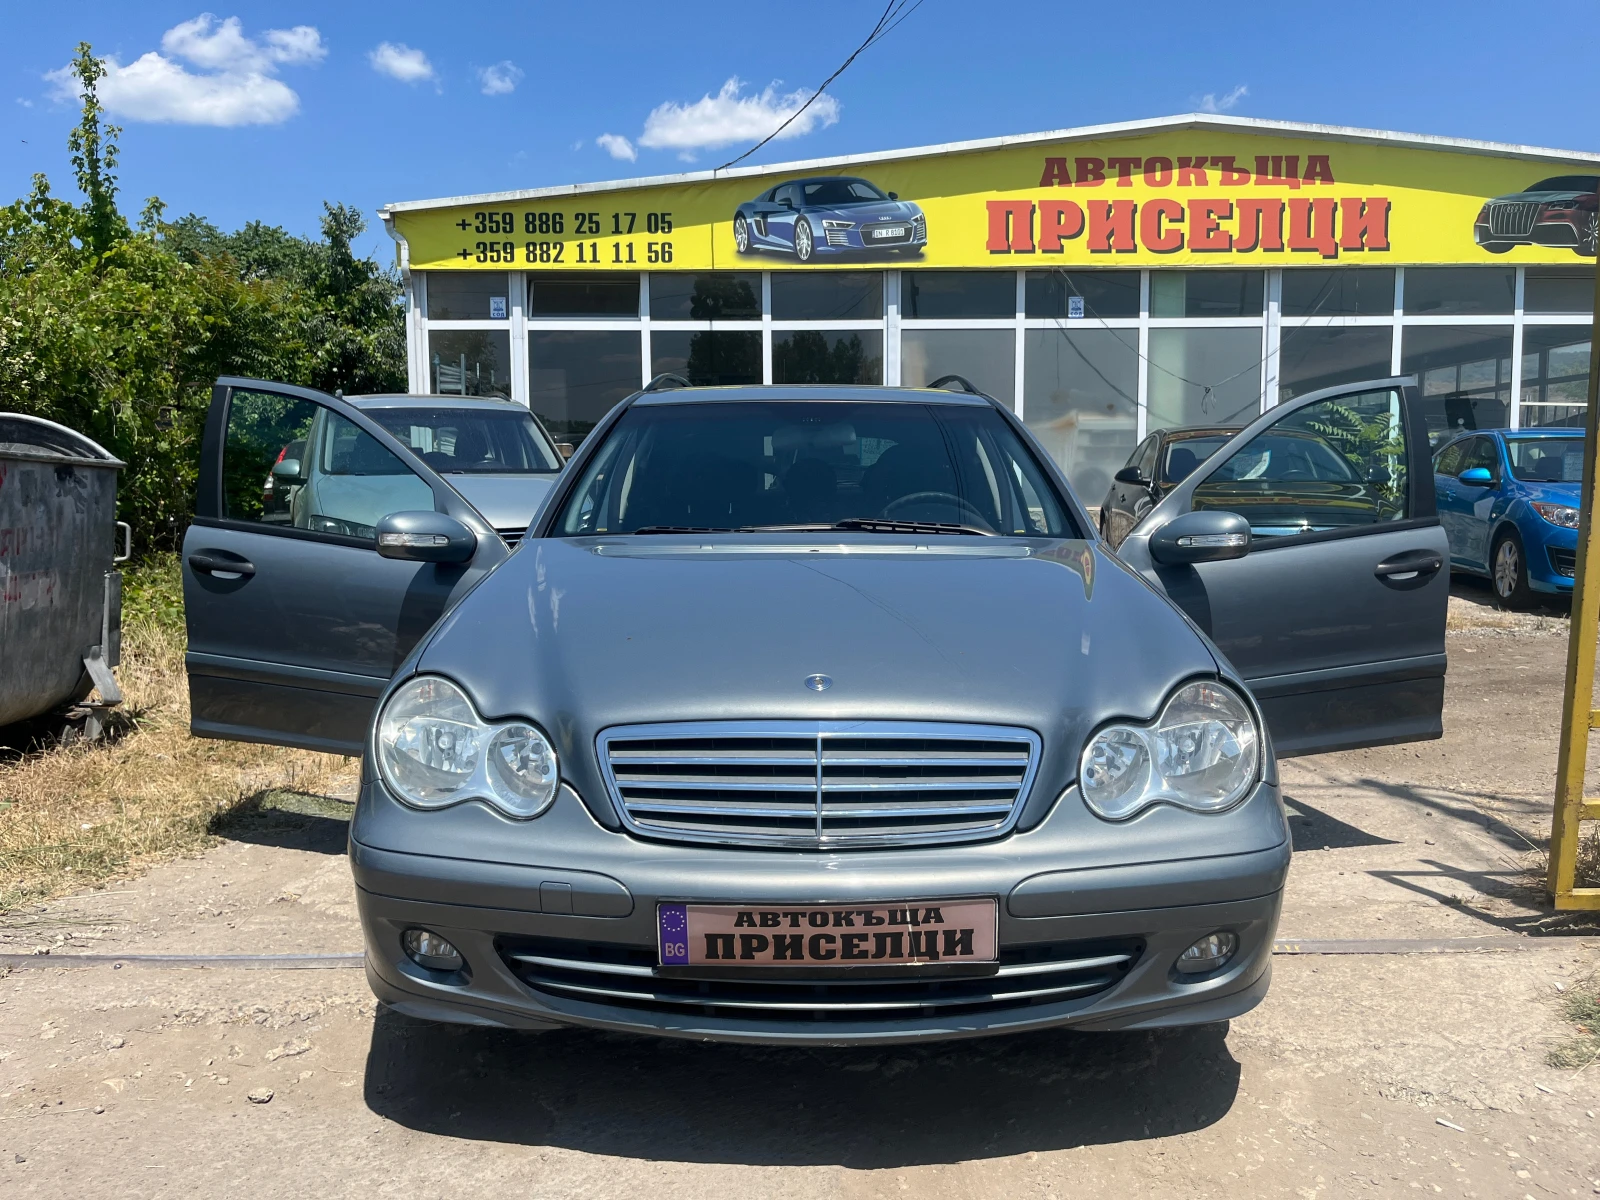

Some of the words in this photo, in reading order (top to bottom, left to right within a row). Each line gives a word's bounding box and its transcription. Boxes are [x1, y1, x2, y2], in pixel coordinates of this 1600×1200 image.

[1039, 155, 1335, 190] АВТОКЪЩА
[456, 212, 514, 234] +359
[524, 212, 564, 234] 886
[574, 212, 600, 234] 25
[611, 212, 637, 234] 17
[646, 212, 673, 234] 05
[985, 197, 1391, 259] ПРИСЕЛЦИ
[457, 242, 515, 263] +359
[525, 242, 565, 263] 882
[576, 242, 600, 263] 11
[612, 242, 636, 263] 11
[647, 242, 673, 263] 56
[733, 907, 945, 927] АВТОКЪЩА
[664, 942, 686, 957] BG
[704, 929, 975, 960] ПРИСЕЛЦИ
